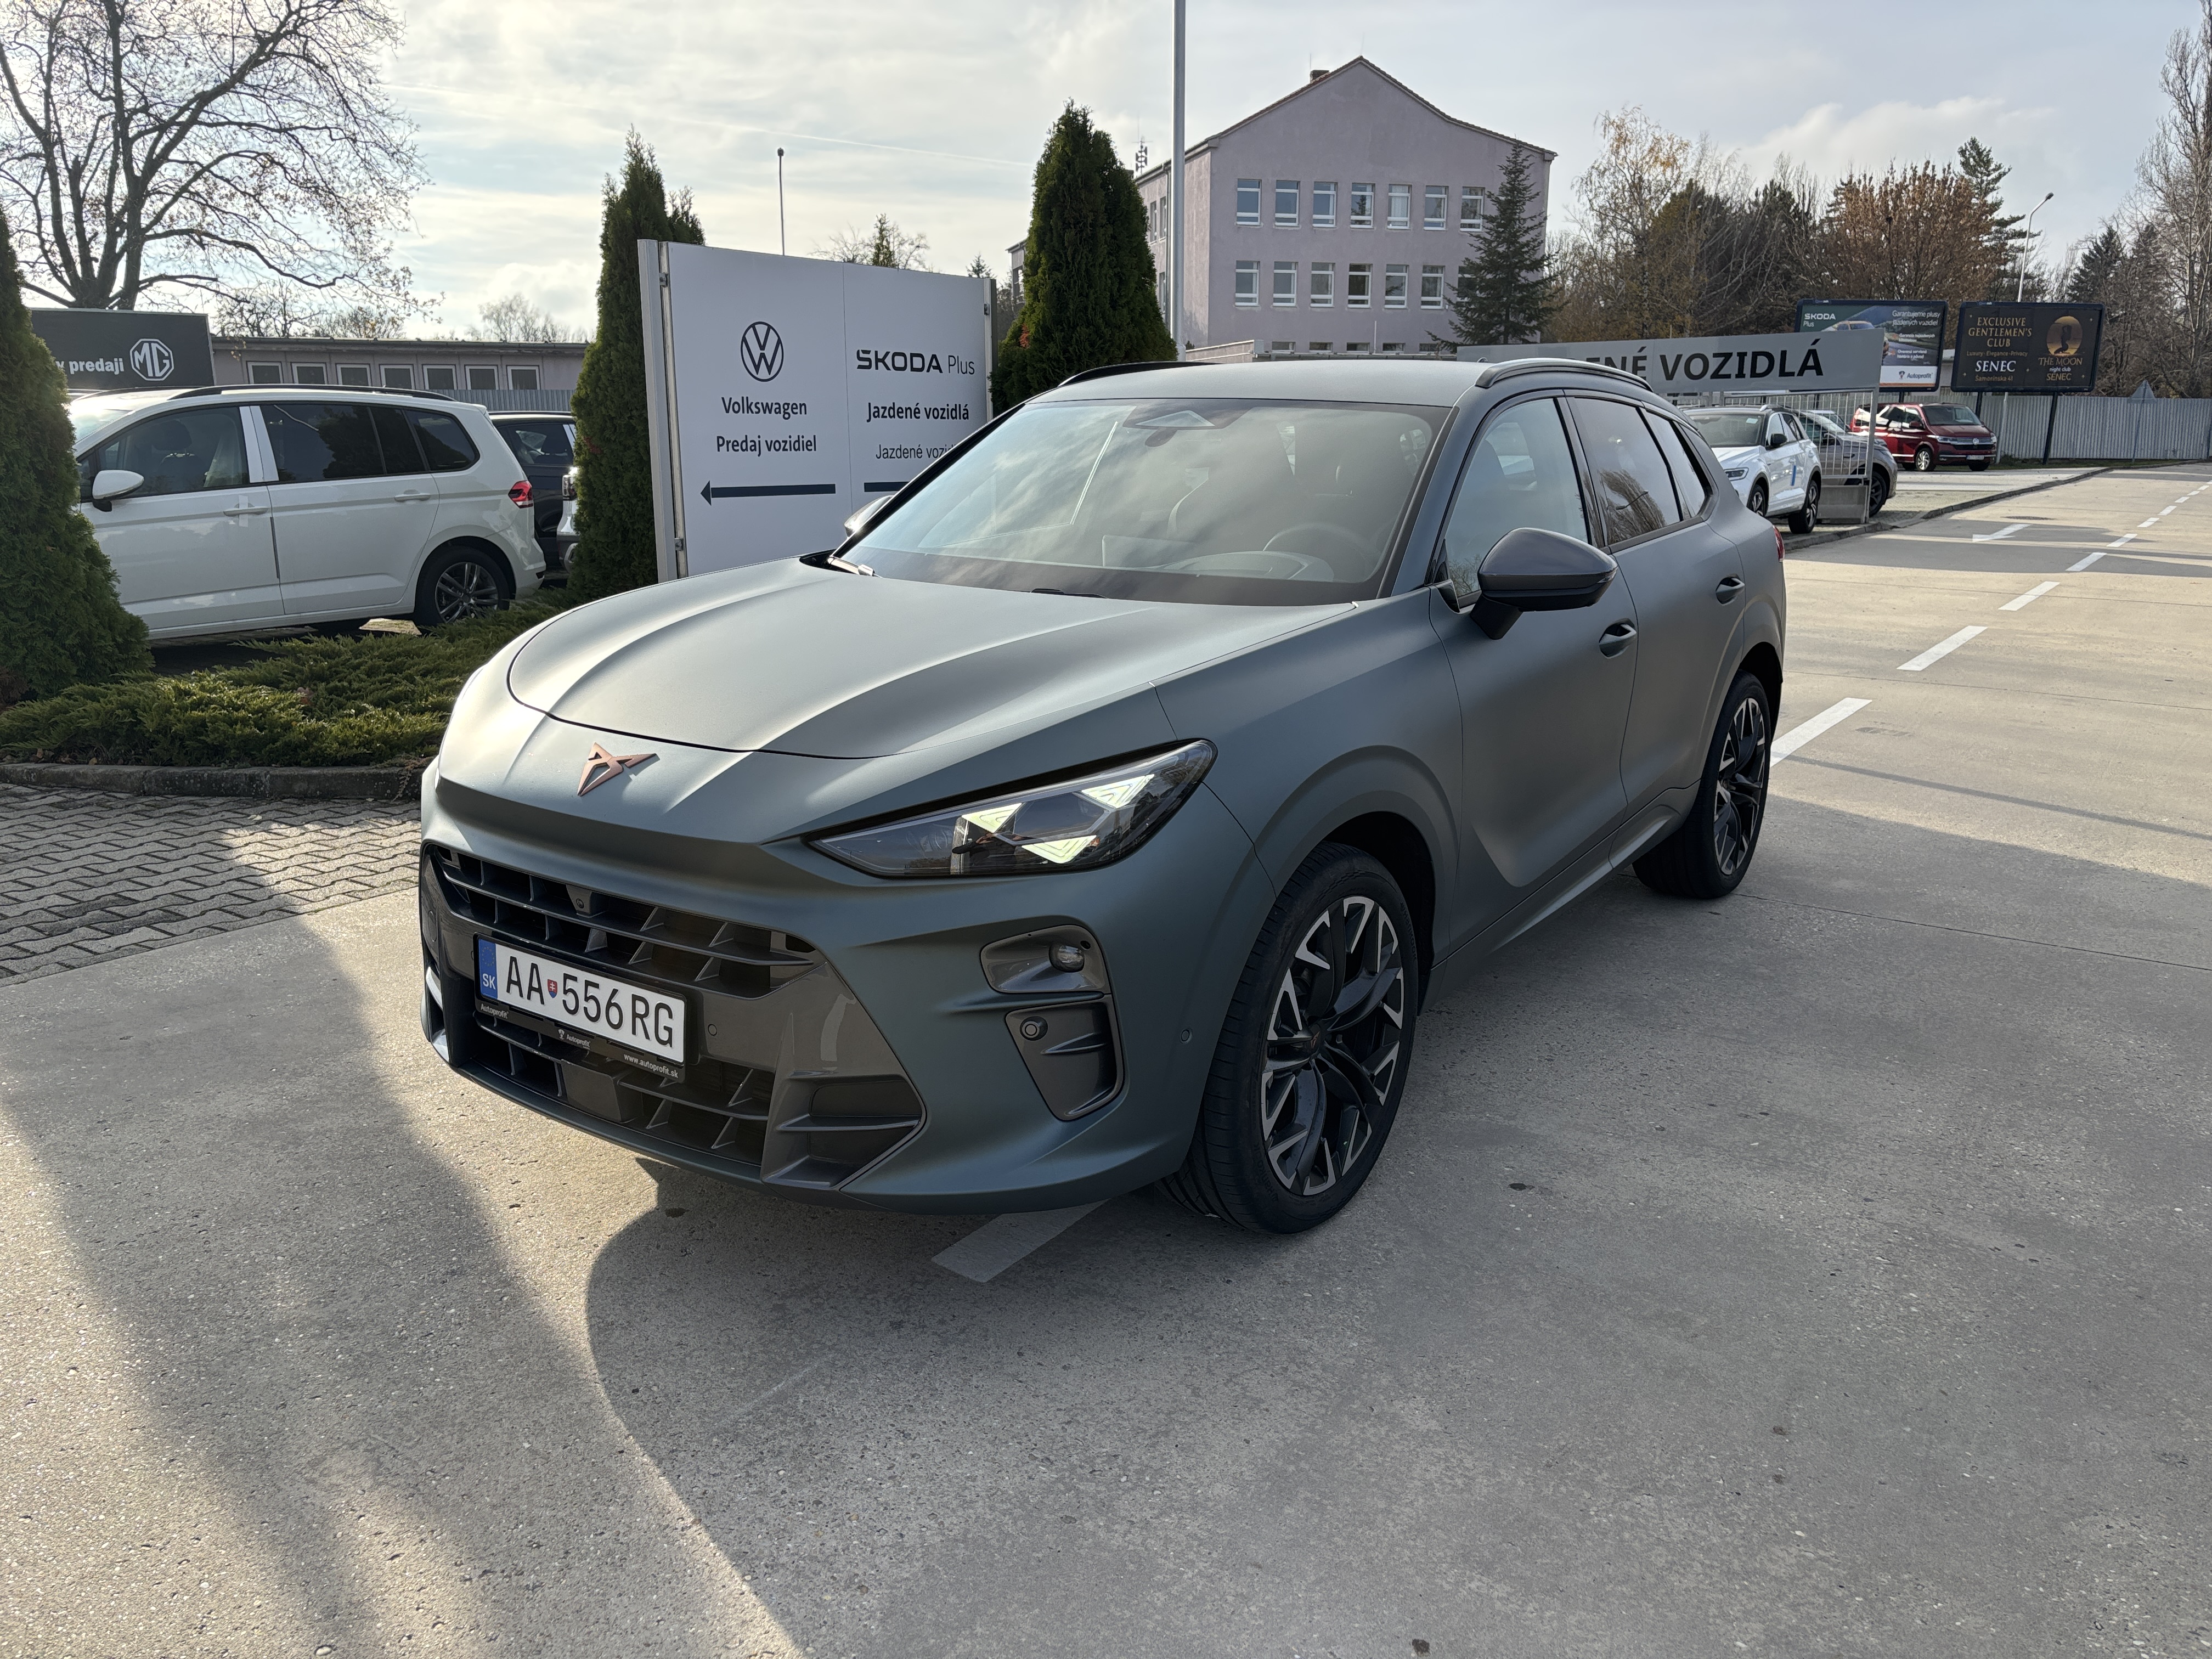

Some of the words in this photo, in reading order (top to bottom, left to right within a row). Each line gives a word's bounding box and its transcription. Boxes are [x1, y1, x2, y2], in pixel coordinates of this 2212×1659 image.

[1977, 317, 2027, 326] EXCLUSIVE
[1968, 328, 2033, 337] GENTLEMEN'S
[1987, 338, 2011, 347] CLUB
[69, 358, 124, 375] predaji
[133, 340, 172, 379] MG
[948, 355, 975, 375] Plus
[1660, 338, 1824, 381] VOZIDLÁ
[1975, 360, 2016, 372] SENEC
[2038, 357, 2054, 366] THE
[2056, 357, 2083, 366] MOON
[721, 396, 807, 420] Volkswagen
[866, 402, 921, 423] Jazdené
[924, 403, 969, 420] vozidlá
[716, 435, 761, 457] Predaj
[765, 435, 817, 452] vozidiel
[876, 444, 923, 459] Jazdené
[483, 973, 496, 990] SK
[481, 1003, 509, 1019] Autoprofit
[566, 1034, 591, 1048] Autoprofit
[623, 1053, 679, 1079] www.autoprofit.sk
